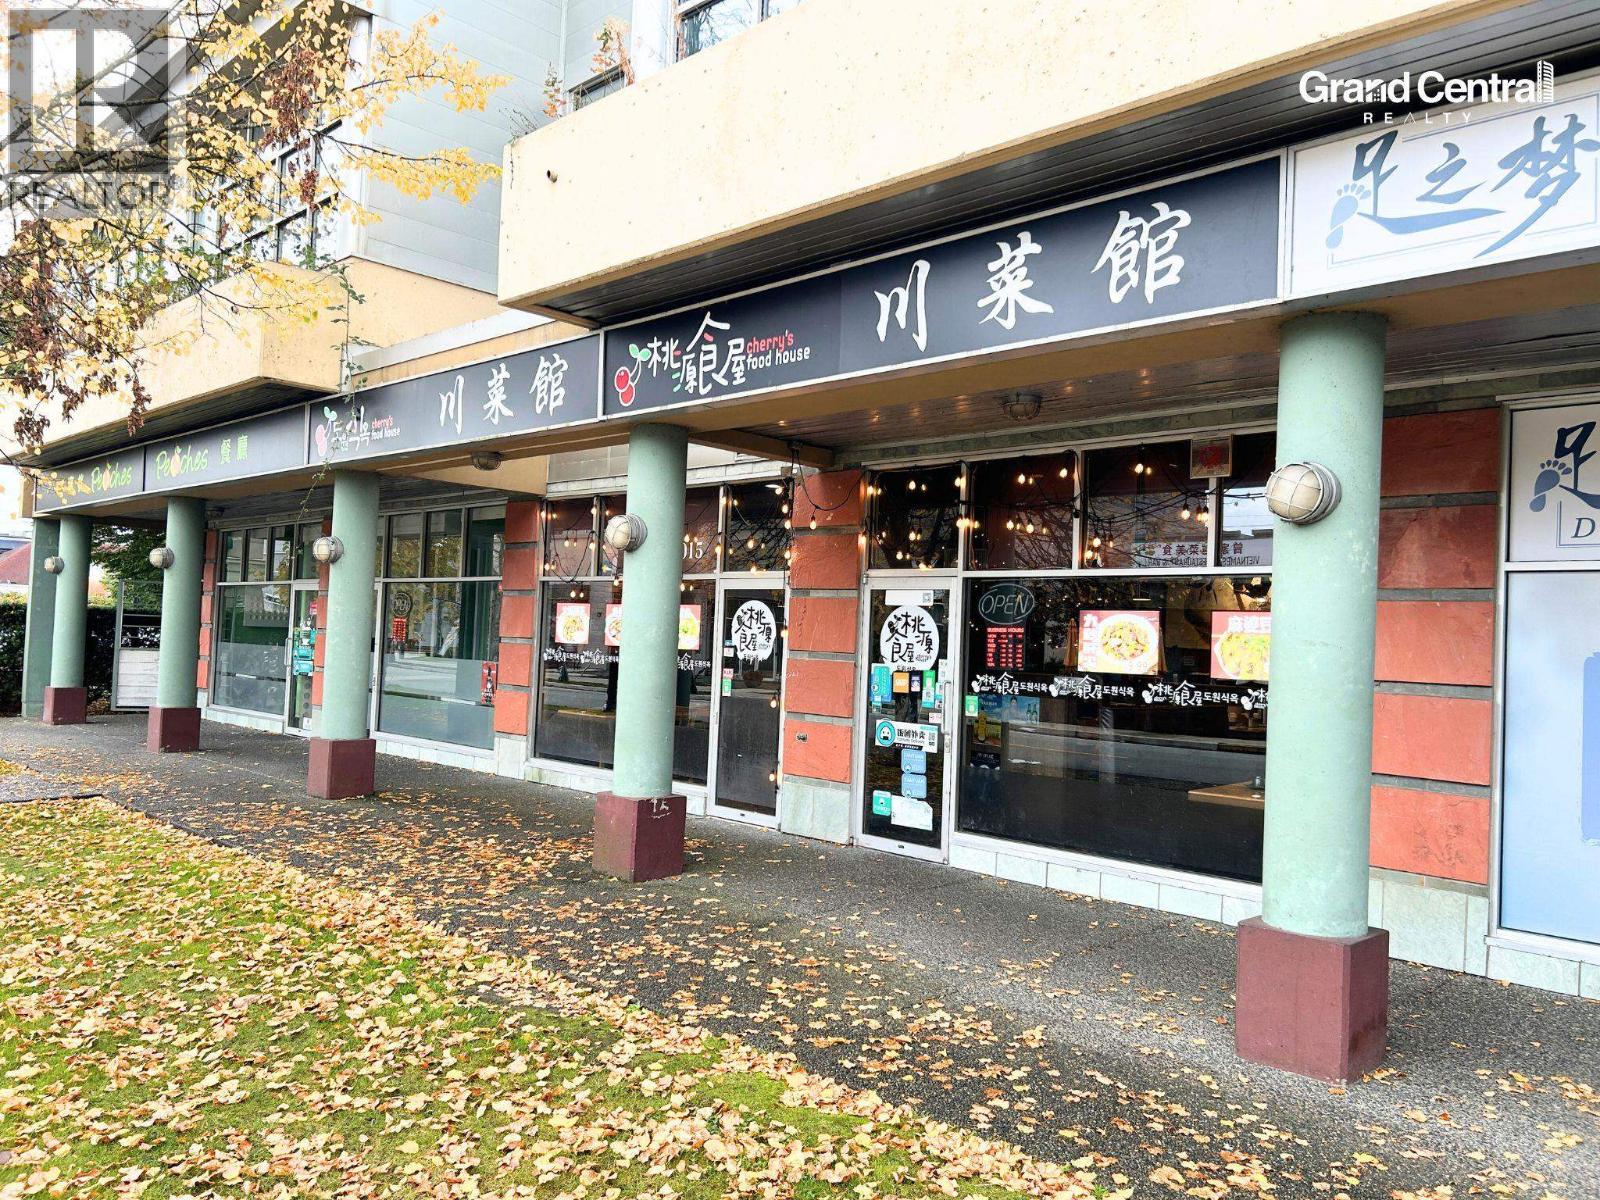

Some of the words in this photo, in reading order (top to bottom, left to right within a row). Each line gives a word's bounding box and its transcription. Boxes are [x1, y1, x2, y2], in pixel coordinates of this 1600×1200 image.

[873, 201, 1192, 352] 川菜館
[746, 329, 794, 354] cherry's
[746, 352, 772, 371] food
[775, 346, 811, 366] house
[439, 353, 569, 435] 川菜館
[371, 415, 394, 429] cherry's
[371, 428, 384, 440] food
[982, 594, 1029, 614] OPEN
